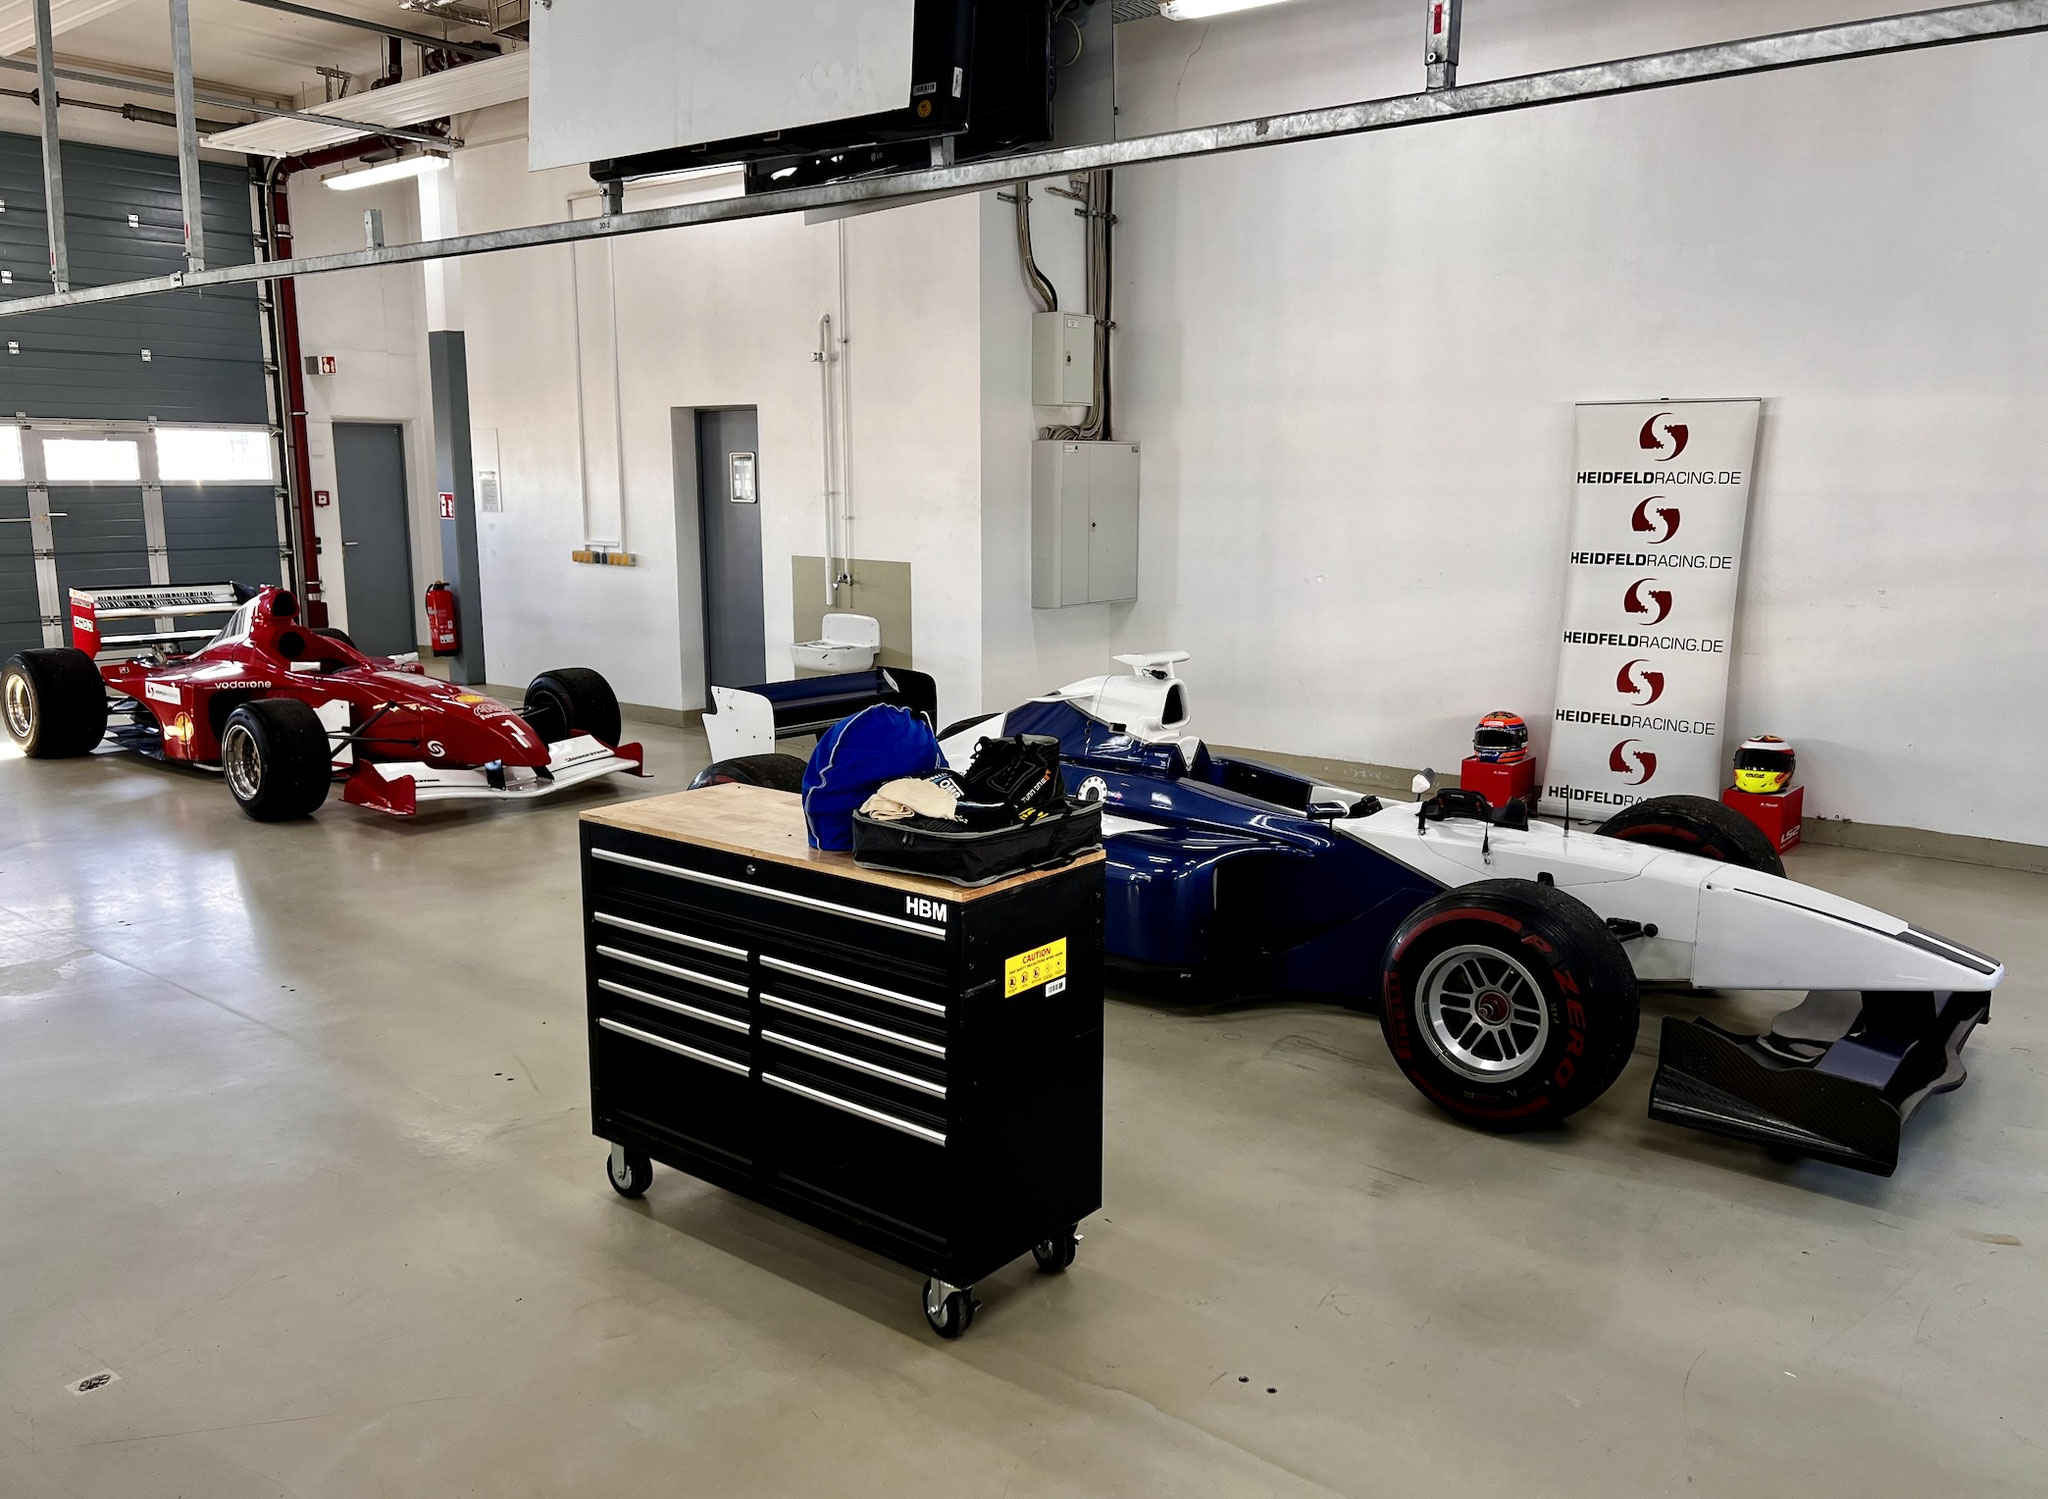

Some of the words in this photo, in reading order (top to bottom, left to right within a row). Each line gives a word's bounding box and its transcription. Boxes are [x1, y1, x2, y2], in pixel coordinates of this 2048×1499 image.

[1576, 471, 1742, 485] HEIDFELDRACING.DE
[1570, 552, 1733, 569] HEIDFELDRACING.DE
[1563, 631, 1724, 653] HEIDFELDRACING.DE
[1555, 709, 1716, 736] HEIDFELDRACING.DE
[1548, 786, 1645, 807] HEIDFELDRA
[1780, 824, 1801, 844] LS2
[906, 896, 947, 922] HBM
[1022, 947, 1051, 964] CAUTION
[1552, 968, 1586, 1089] ZERO
